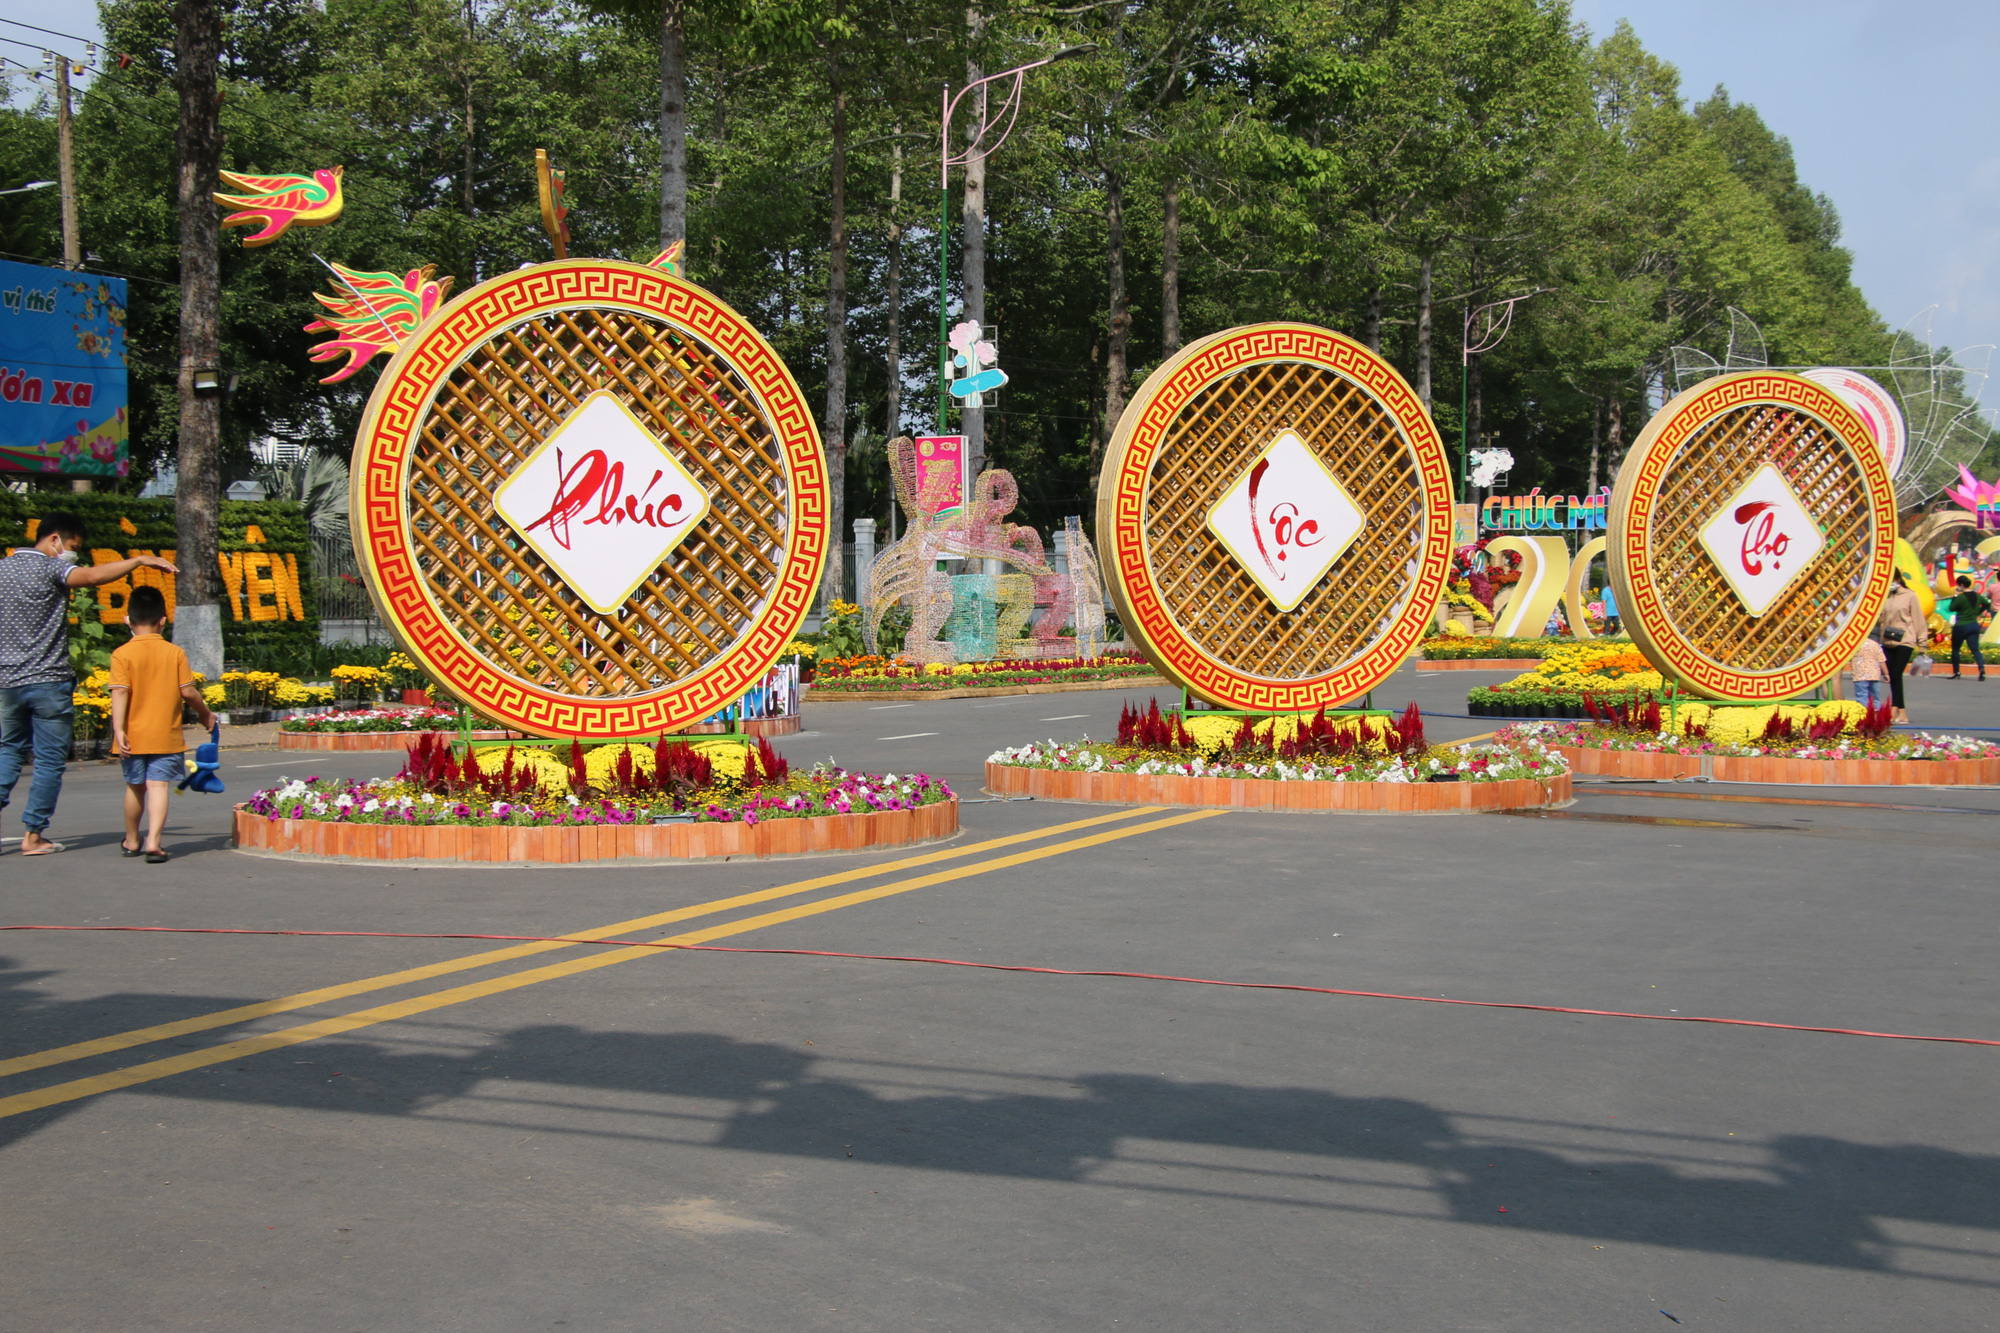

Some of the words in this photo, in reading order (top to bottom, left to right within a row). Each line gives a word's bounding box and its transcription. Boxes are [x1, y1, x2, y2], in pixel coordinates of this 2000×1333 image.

[3, 286, 22, 315] vị
[25, 287, 58, 314] thế
[48, 379, 94, 408] xa
[524, 446, 692, 550] Phúc
[1249, 457, 1326, 581] Lộc
[1482, 487, 1564, 530] CHÚC
[218, 524, 304, 622] YÊN
[1734, 500, 1793, 576] Thọ
